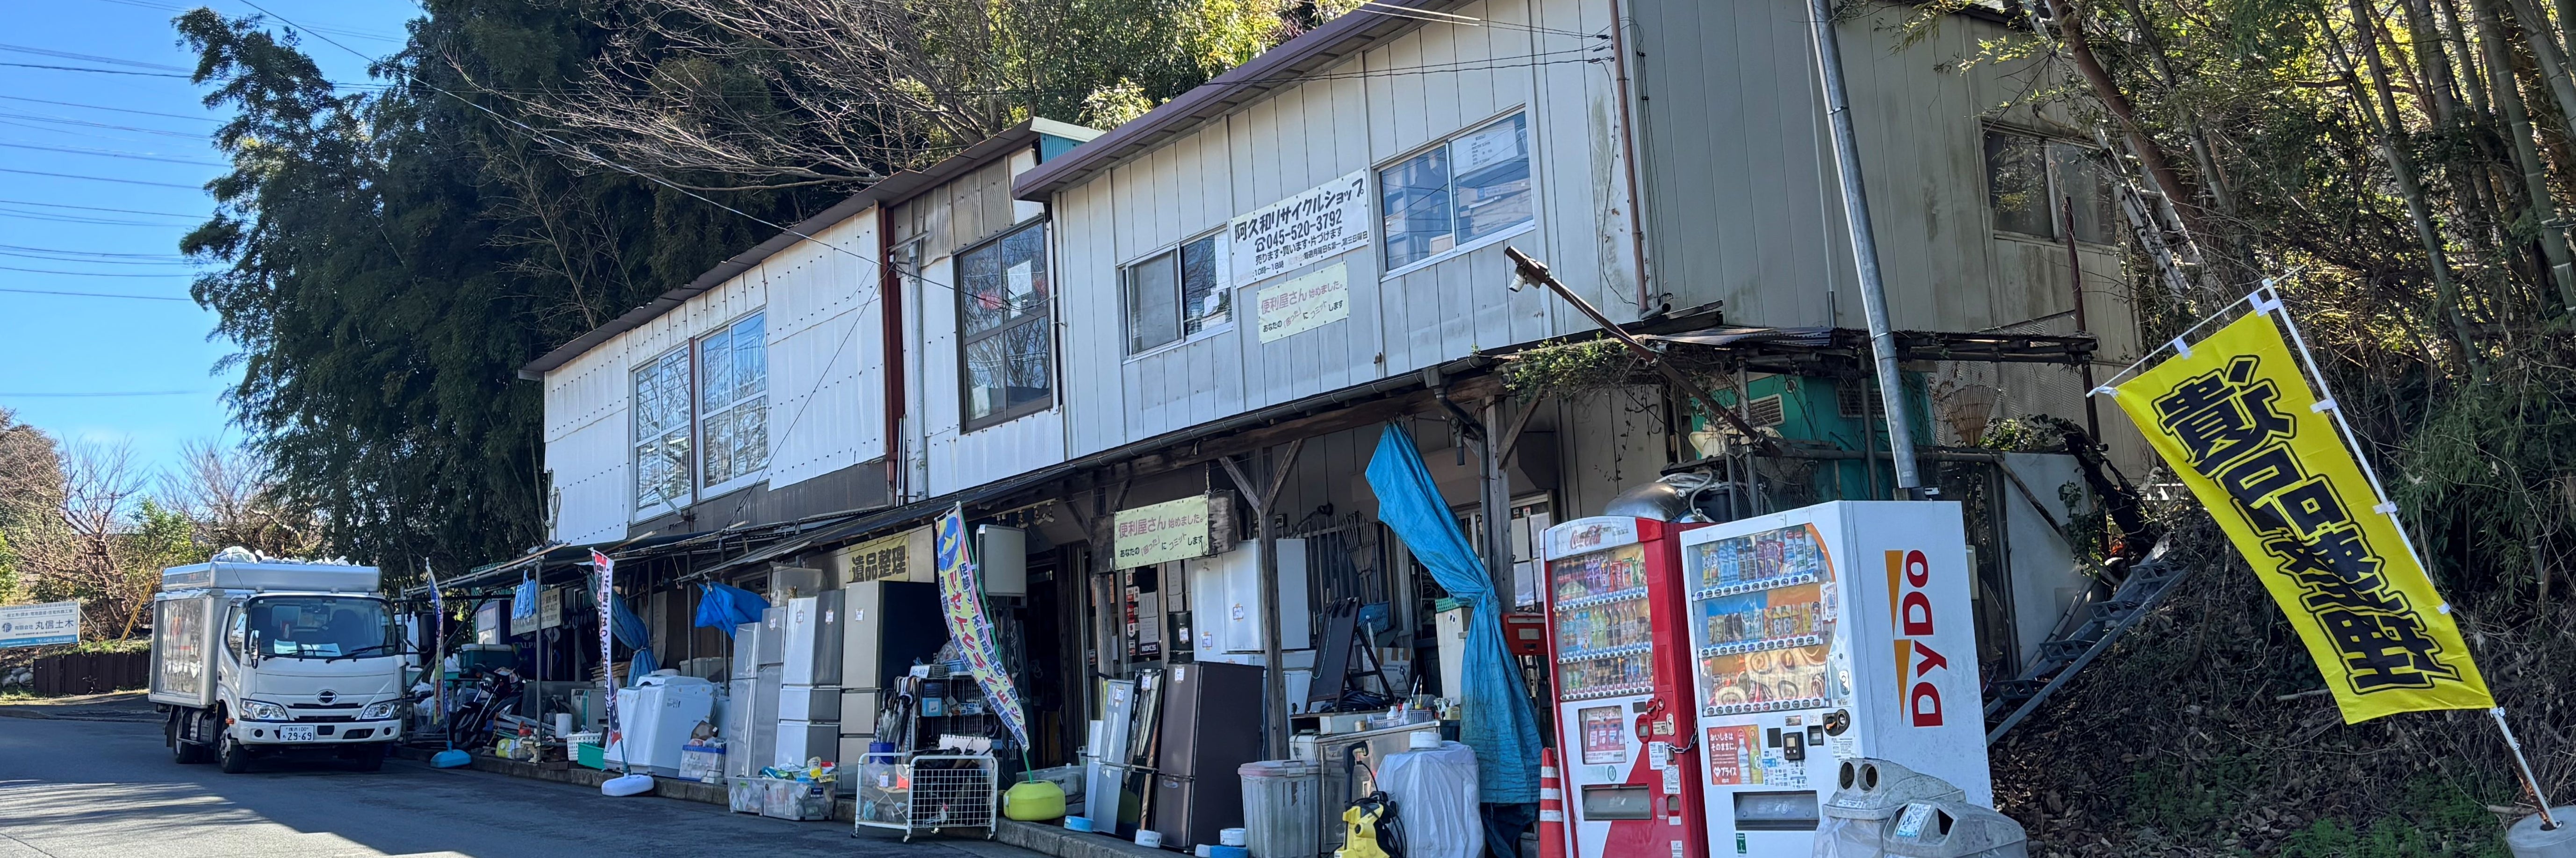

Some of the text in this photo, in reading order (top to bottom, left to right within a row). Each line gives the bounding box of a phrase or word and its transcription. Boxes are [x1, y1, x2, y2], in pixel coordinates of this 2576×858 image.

[1235, 178, 1364, 243] 阿久和リサイクルショップ
[1266, 208, 1342, 250] 045-520-3792
[846, 545, 906, 583] 遺品整理
[288, 732, 312, 741] 29-69
[1710, 732, 1734, 742] おいしさは
